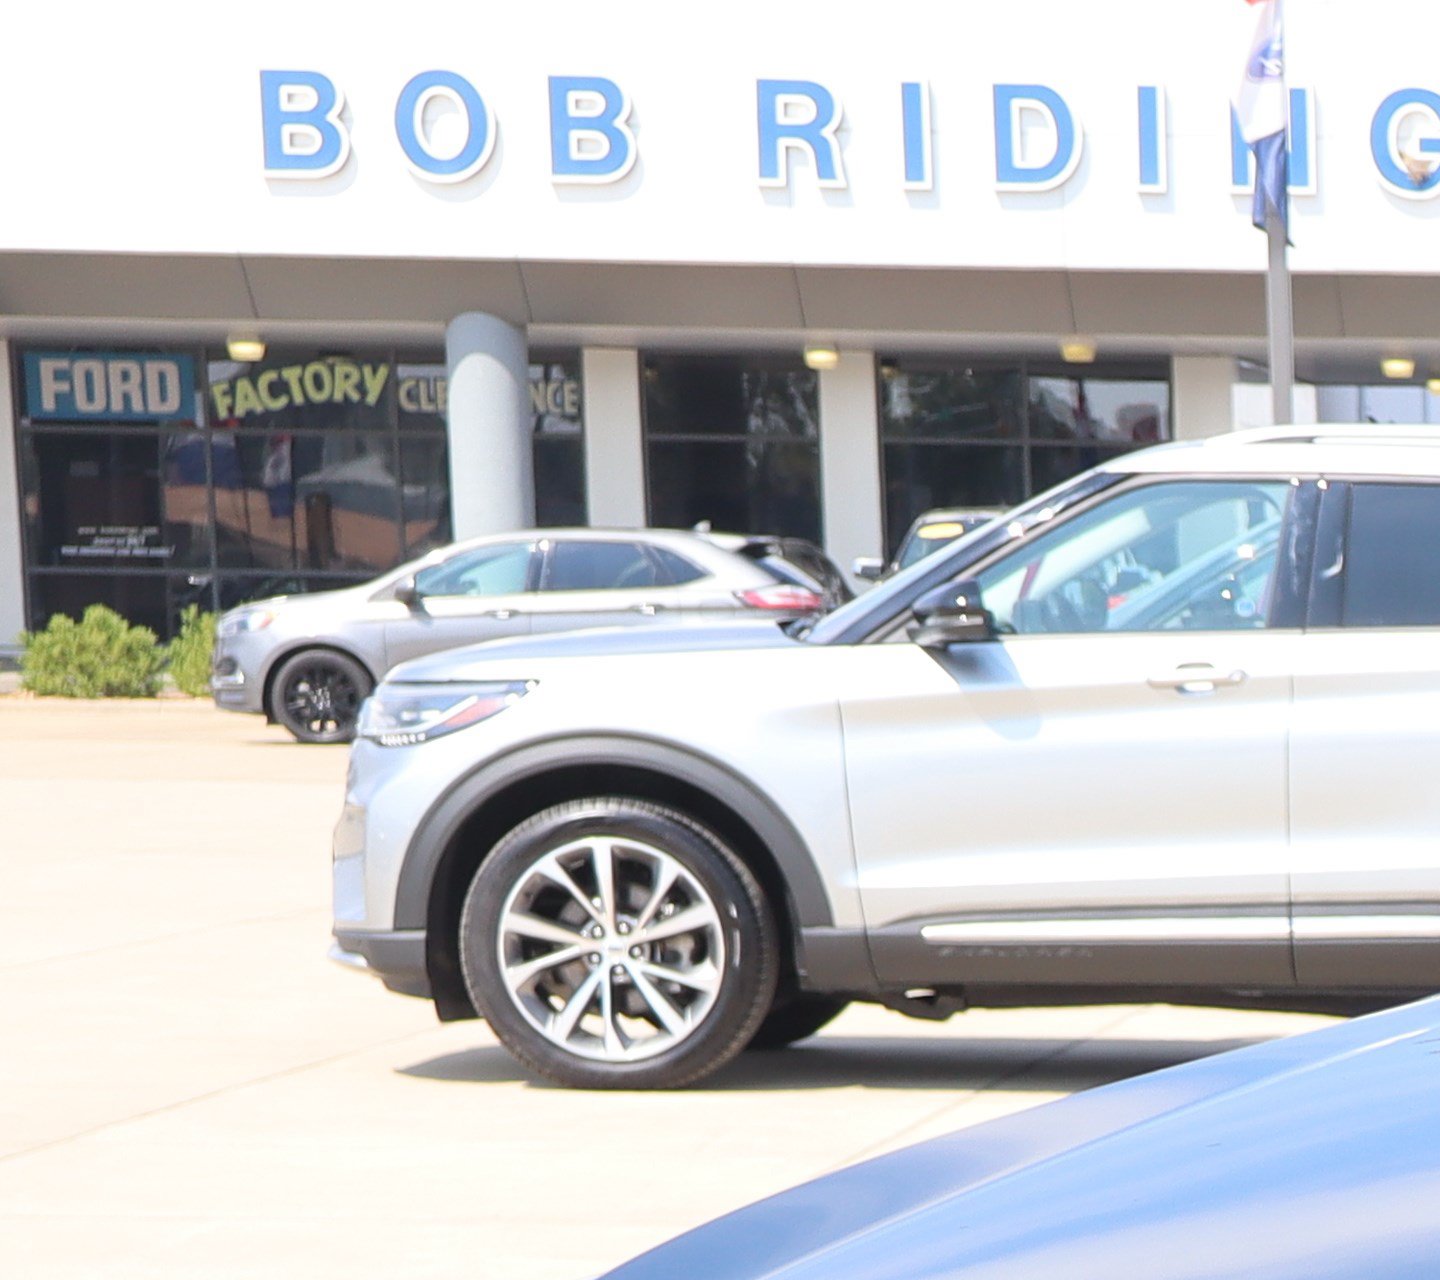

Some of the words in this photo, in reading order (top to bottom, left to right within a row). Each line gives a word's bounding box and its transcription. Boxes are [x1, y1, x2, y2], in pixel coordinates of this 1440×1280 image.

[260, 68, 640, 185] BOB
[39, 359, 183, 414] FORD
[211, 361, 391, 420] FACTORY
[399, 377, 579, 415] CLENCE
